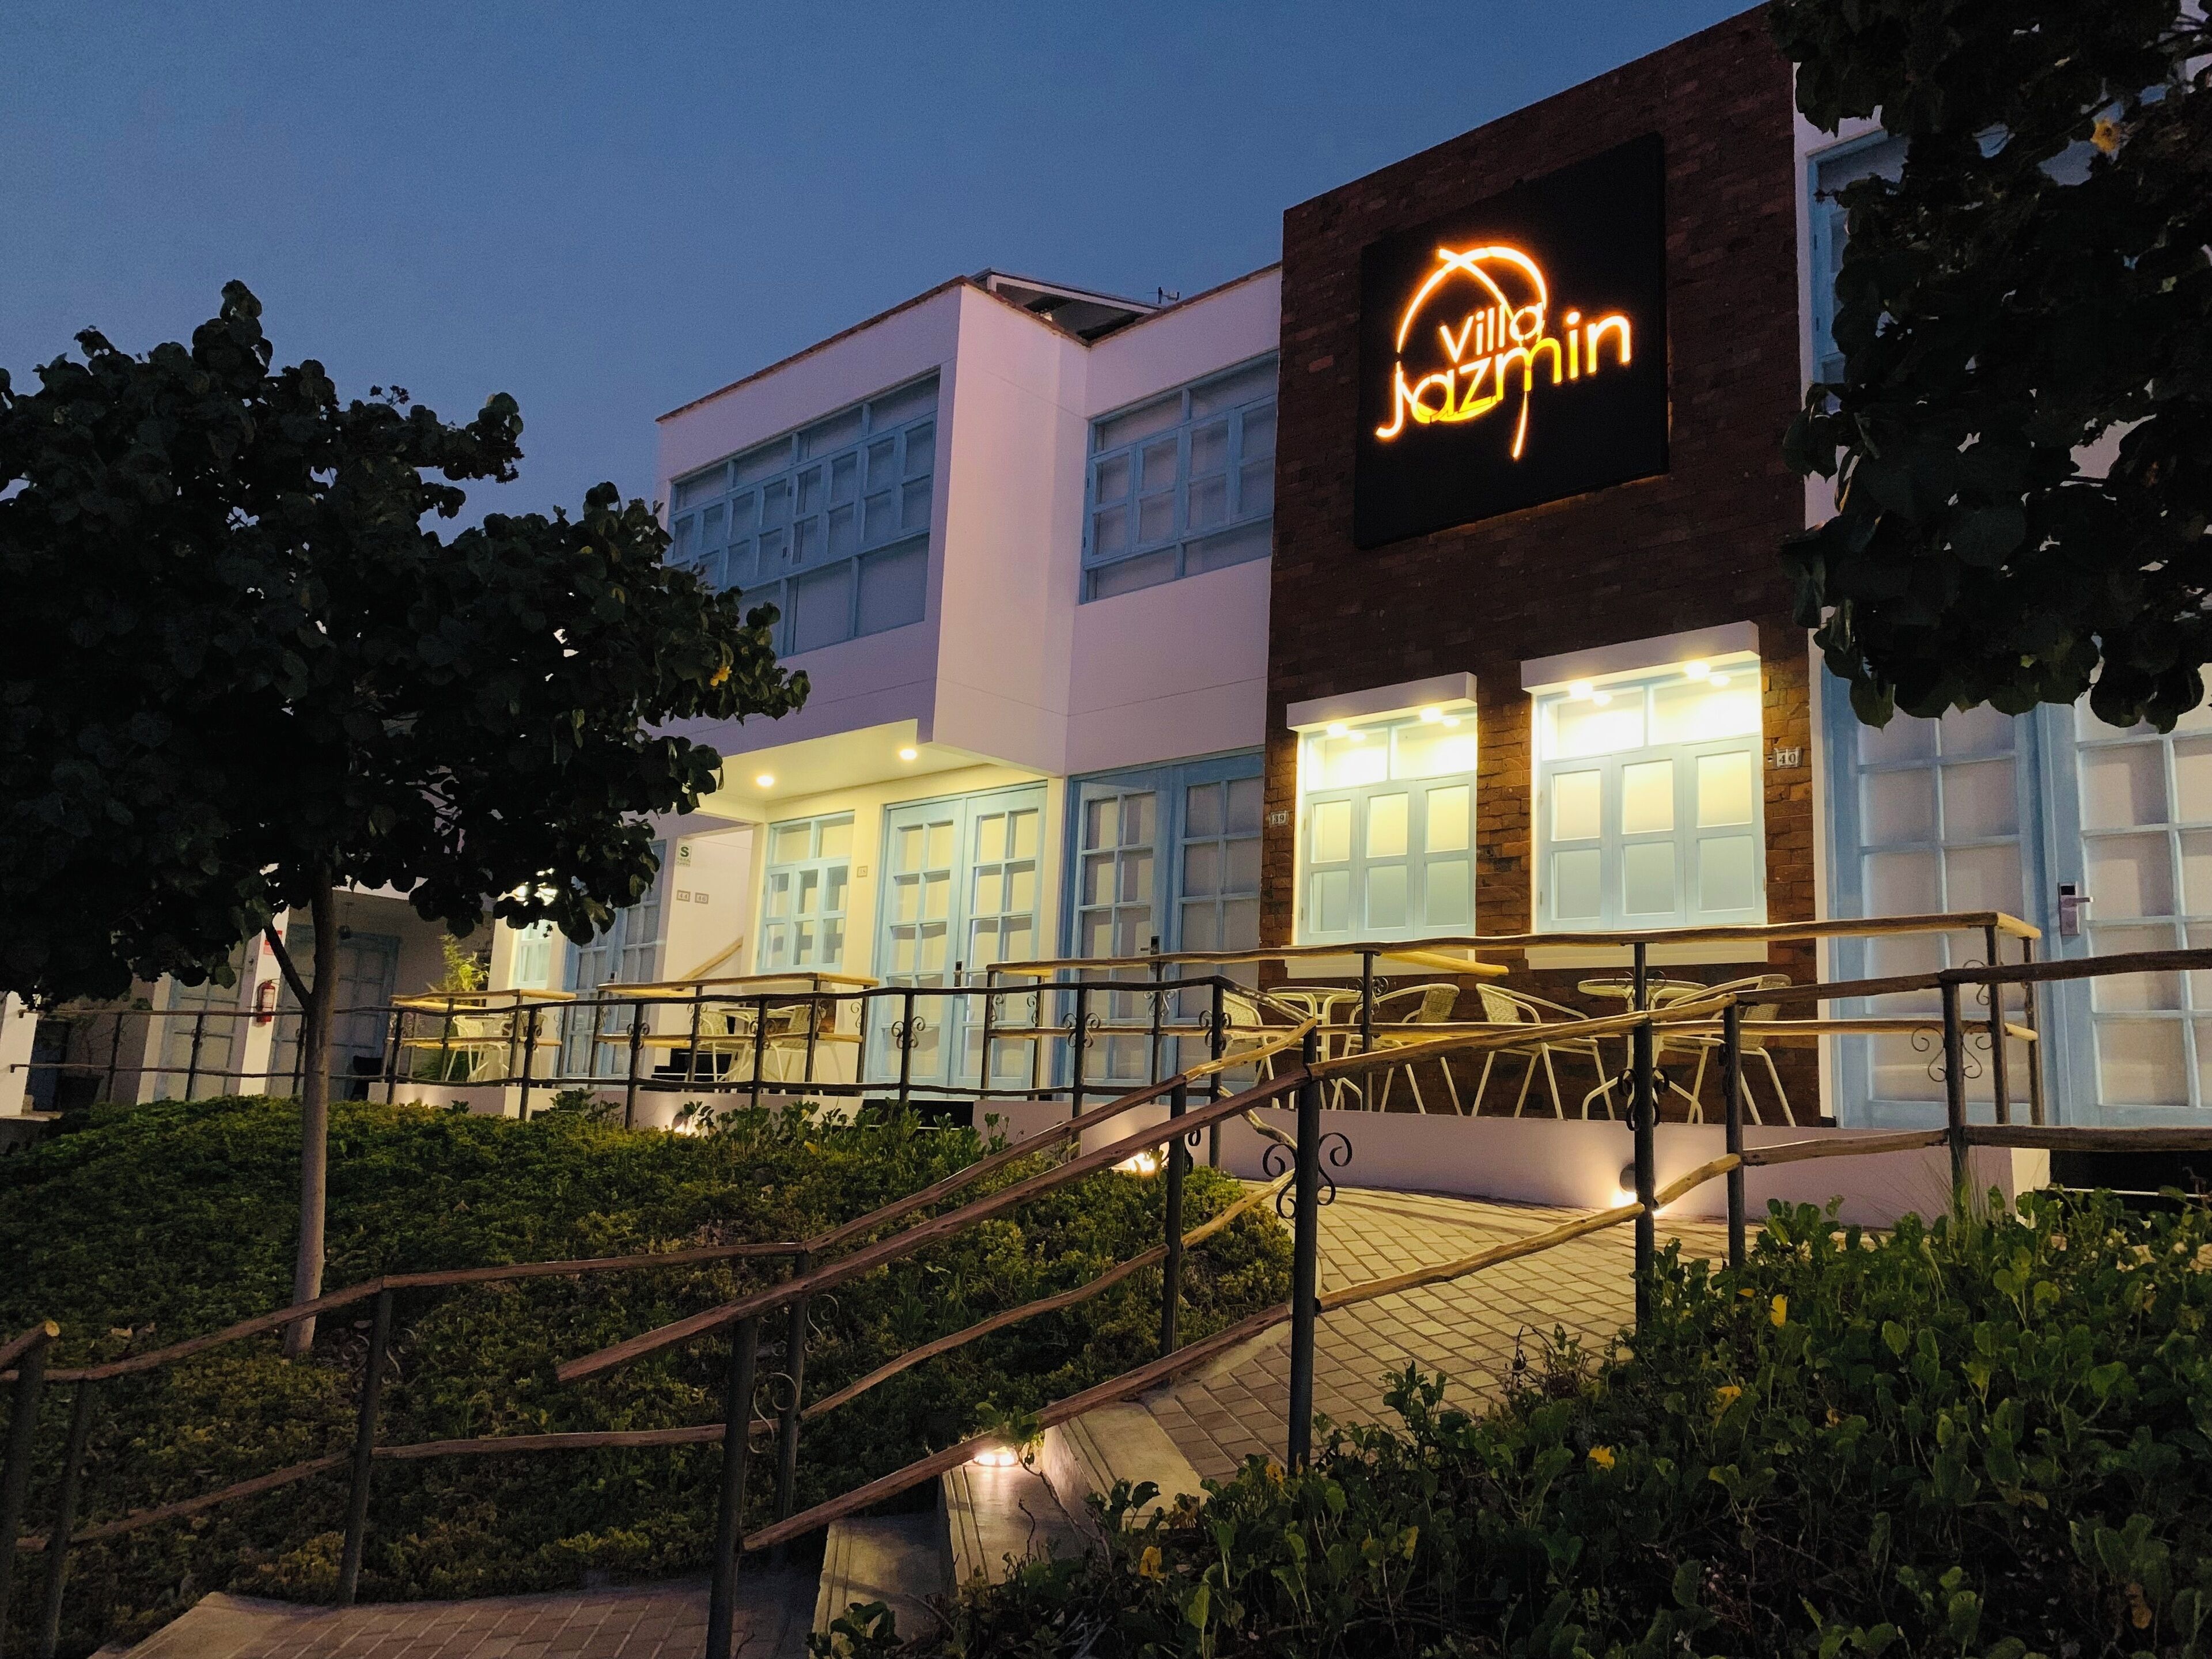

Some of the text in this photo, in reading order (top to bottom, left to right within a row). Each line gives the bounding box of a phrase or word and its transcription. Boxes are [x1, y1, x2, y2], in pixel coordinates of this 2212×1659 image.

[1440, 301, 1546, 364] villa
[1778, 753, 1797, 764] 40
[680, 846, 689, 857] S
